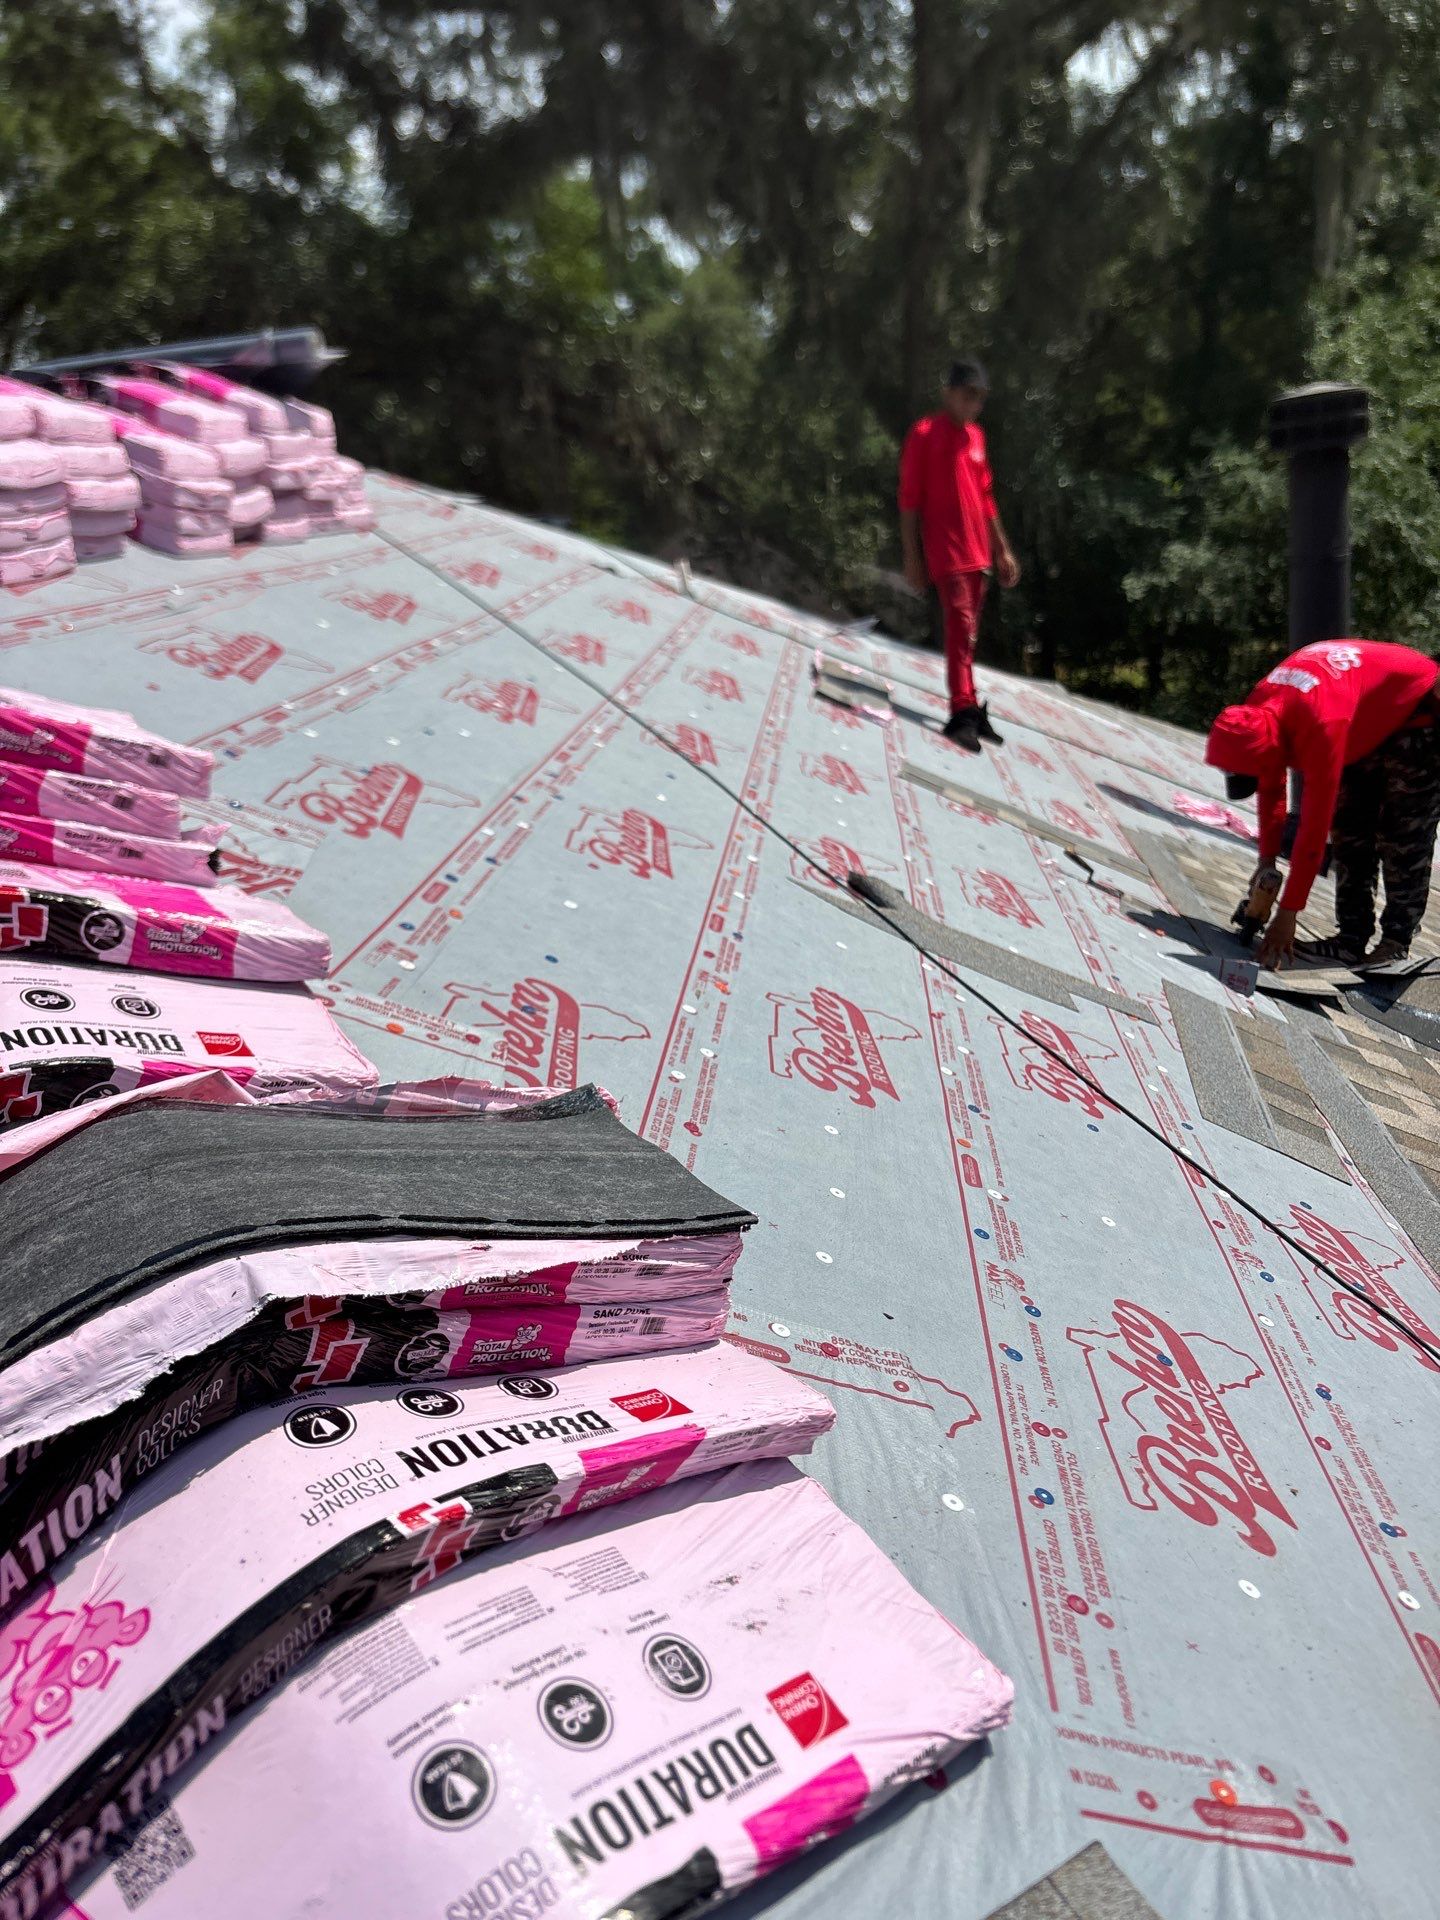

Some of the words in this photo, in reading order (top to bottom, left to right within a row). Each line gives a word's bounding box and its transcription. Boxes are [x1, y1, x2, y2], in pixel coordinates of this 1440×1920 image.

[1, 1030, 183, 1051] DURATION
[482, 977, 552, 1087] rehm
[856, 1029, 889, 1084] ROOFING
[464, 1283, 549, 1296] PROTECTION
[1356, 1260, 1430, 1333] ROOFING
[593, 1308, 623, 1319] SAND
[733, 1311, 748, 1322] MS
[469, 1347, 548, 1363] PROTECTION
[479, 1340, 508, 1352] TOTAL
[802, 1338, 845, 1354] INTEK
[848, 1349, 873, 1361] CODE
[829, 1336, 911, 1363] 855-MAX-FELT
[846, 1355, 883, 1370] REPORT
[1000, 1361, 1012, 1390] FLORIDA
[617, 1391, 662, 1405] CORNING
[622, 1397, 662, 1410] OWENS
[1005, 1389, 1019, 1426] APPROVAL
[138, 1378, 224, 1455] DESIGNER
[296, 1411, 317, 1422] YEAR
[1021, 1412, 1030, 1423] OF
[1107, 1299, 1276, 1557] Brehm
[395, 1409, 612, 1478] DURATION
[561, 1426, 618, 1444] TRUDEFINITION
[1015, 1443, 1024, 1453] FL
[1023, 1423, 1038, 1466] INSURANCE
[1189, 1377, 1269, 1492] ROOFING
[1050, 1438, 1063, 1464] COVER
[304, 1458, 384, 1500] COLORS
[1066, 1451, 1084, 1491] FOLLOW
[300, 1473, 399, 1527] DESIGNER
[1056, 1463, 1074, 1513] IMMEDIATELY
[1074, 1488, 1087, 1508] ALL
[1067, 1512, 1079, 1537] WHEN
[1079, 1507, 1094, 1536] OSHA
[1042, 1517, 1060, 1563] CERTIFIED
[1073, 1536, 1086, 1565] USING
[1085, 1535, 1109, 1599] GUIDELINES
[1079, 1563, 1095, 1606] STAPLES
[240, 1604, 332, 1691] DESIGNER
[772, 1677, 818, 1710] CORNING
[780, 1693, 819, 1722] OWENS
[551, 1723, 777, 1868] DURATION
